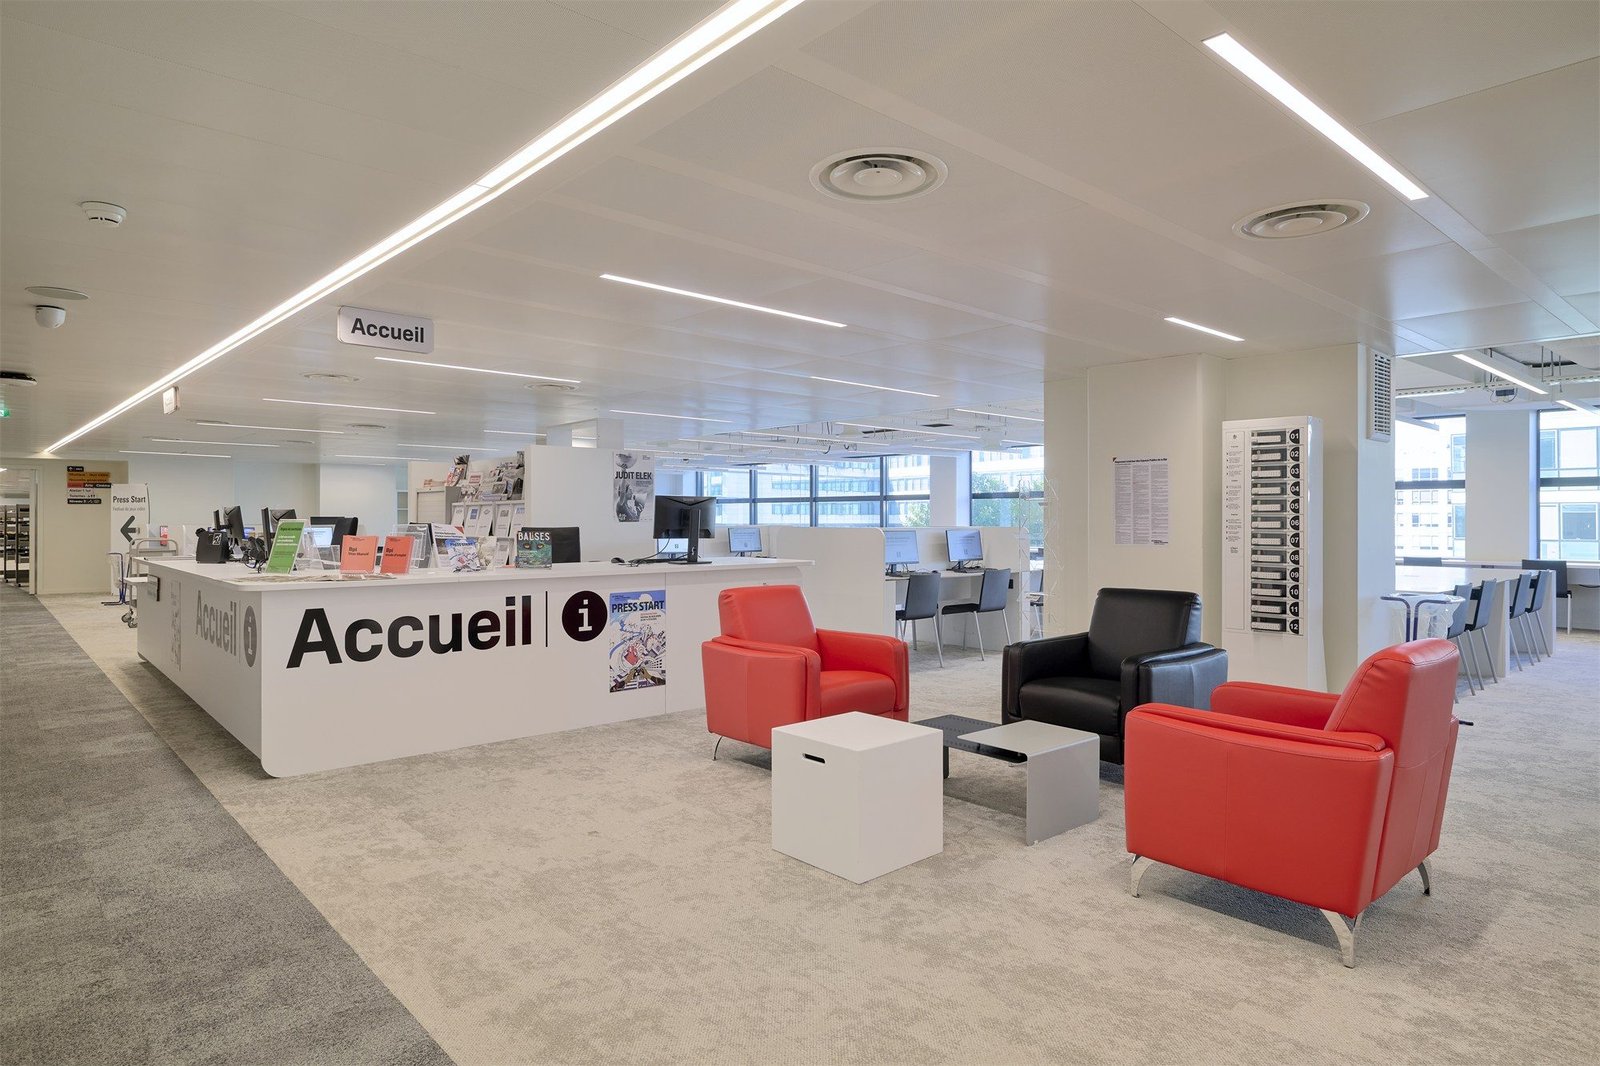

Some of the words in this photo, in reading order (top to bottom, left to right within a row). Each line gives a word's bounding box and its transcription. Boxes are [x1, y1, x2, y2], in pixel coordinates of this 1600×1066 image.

[351, 317, 425, 343] Accueil
[615, 471, 635, 480] JUDIT
[635, 471, 653, 480] ELEK
[112, 495, 130, 504] Press
[130, 495, 146, 504] Start
[611, 602, 638, 614] PRESS
[638, 600, 665, 611] START
[195, 590, 237, 656] Accueil
[286, 595, 532, 669] Accueil
